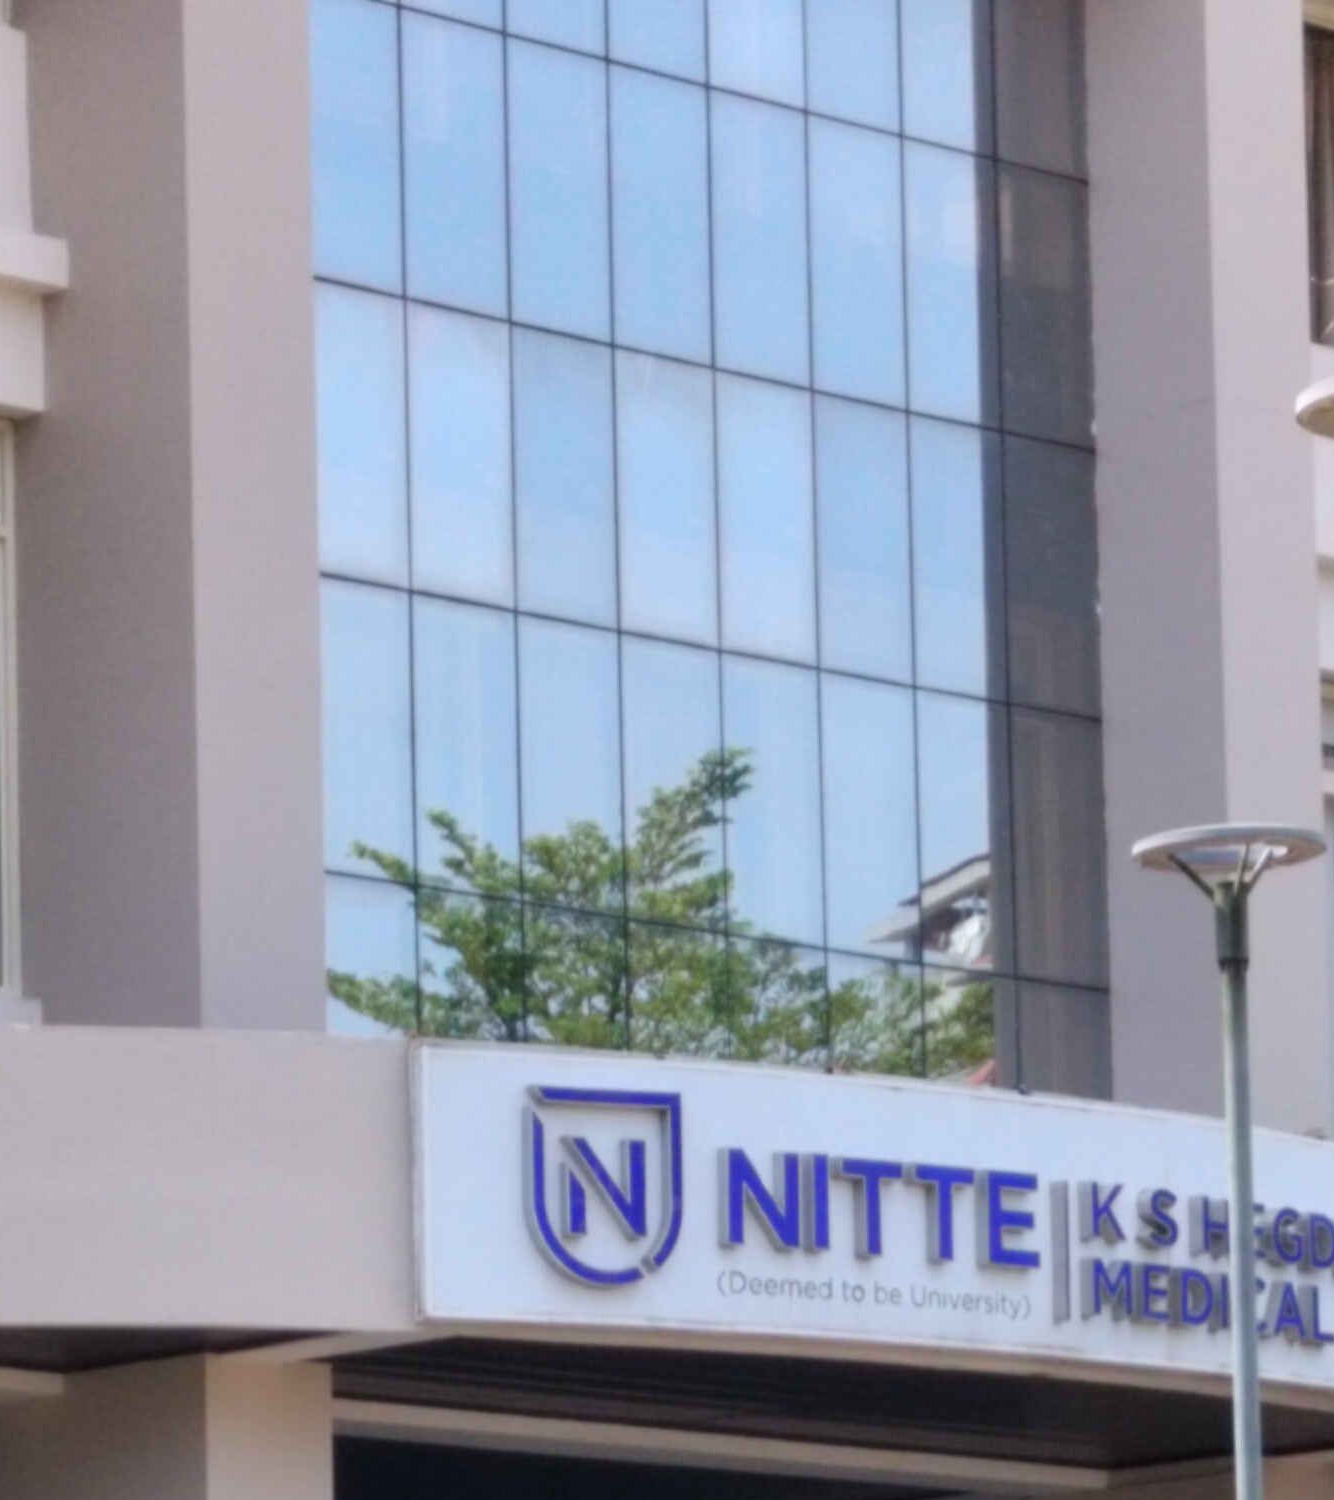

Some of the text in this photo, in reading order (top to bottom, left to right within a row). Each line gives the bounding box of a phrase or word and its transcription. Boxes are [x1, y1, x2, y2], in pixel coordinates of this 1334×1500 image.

[720, 1148, 1040, 1268] NITTE
[1083, 1182, 1127, 1243] K
[1141, 1188, 1179, 1249] S
[717, 1269, 1032, 1321] (Deemed to be University)
